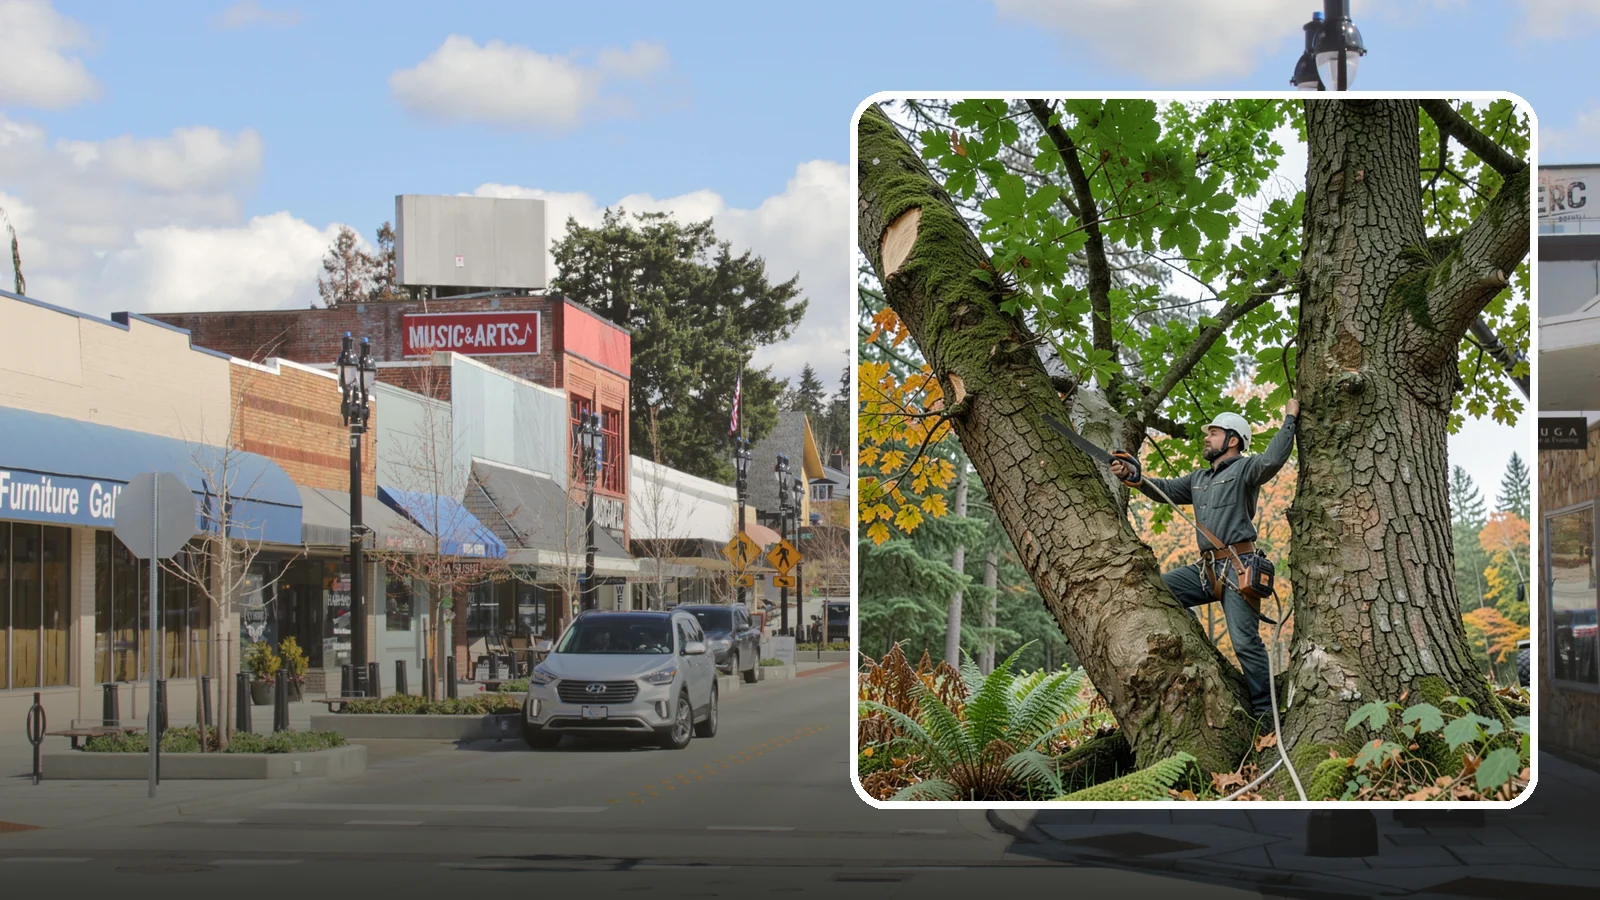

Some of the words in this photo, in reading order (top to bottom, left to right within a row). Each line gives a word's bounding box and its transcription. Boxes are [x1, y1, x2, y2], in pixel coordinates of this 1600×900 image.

[408, 323, 519, 348] MUSIC&ARTS
[1540, 427, 1577, 437] UGA
[0, 471, 79, 515] Furniture
[89, 482, 122, 519] Gal
[454, 563, 478, 574] SUSHI
